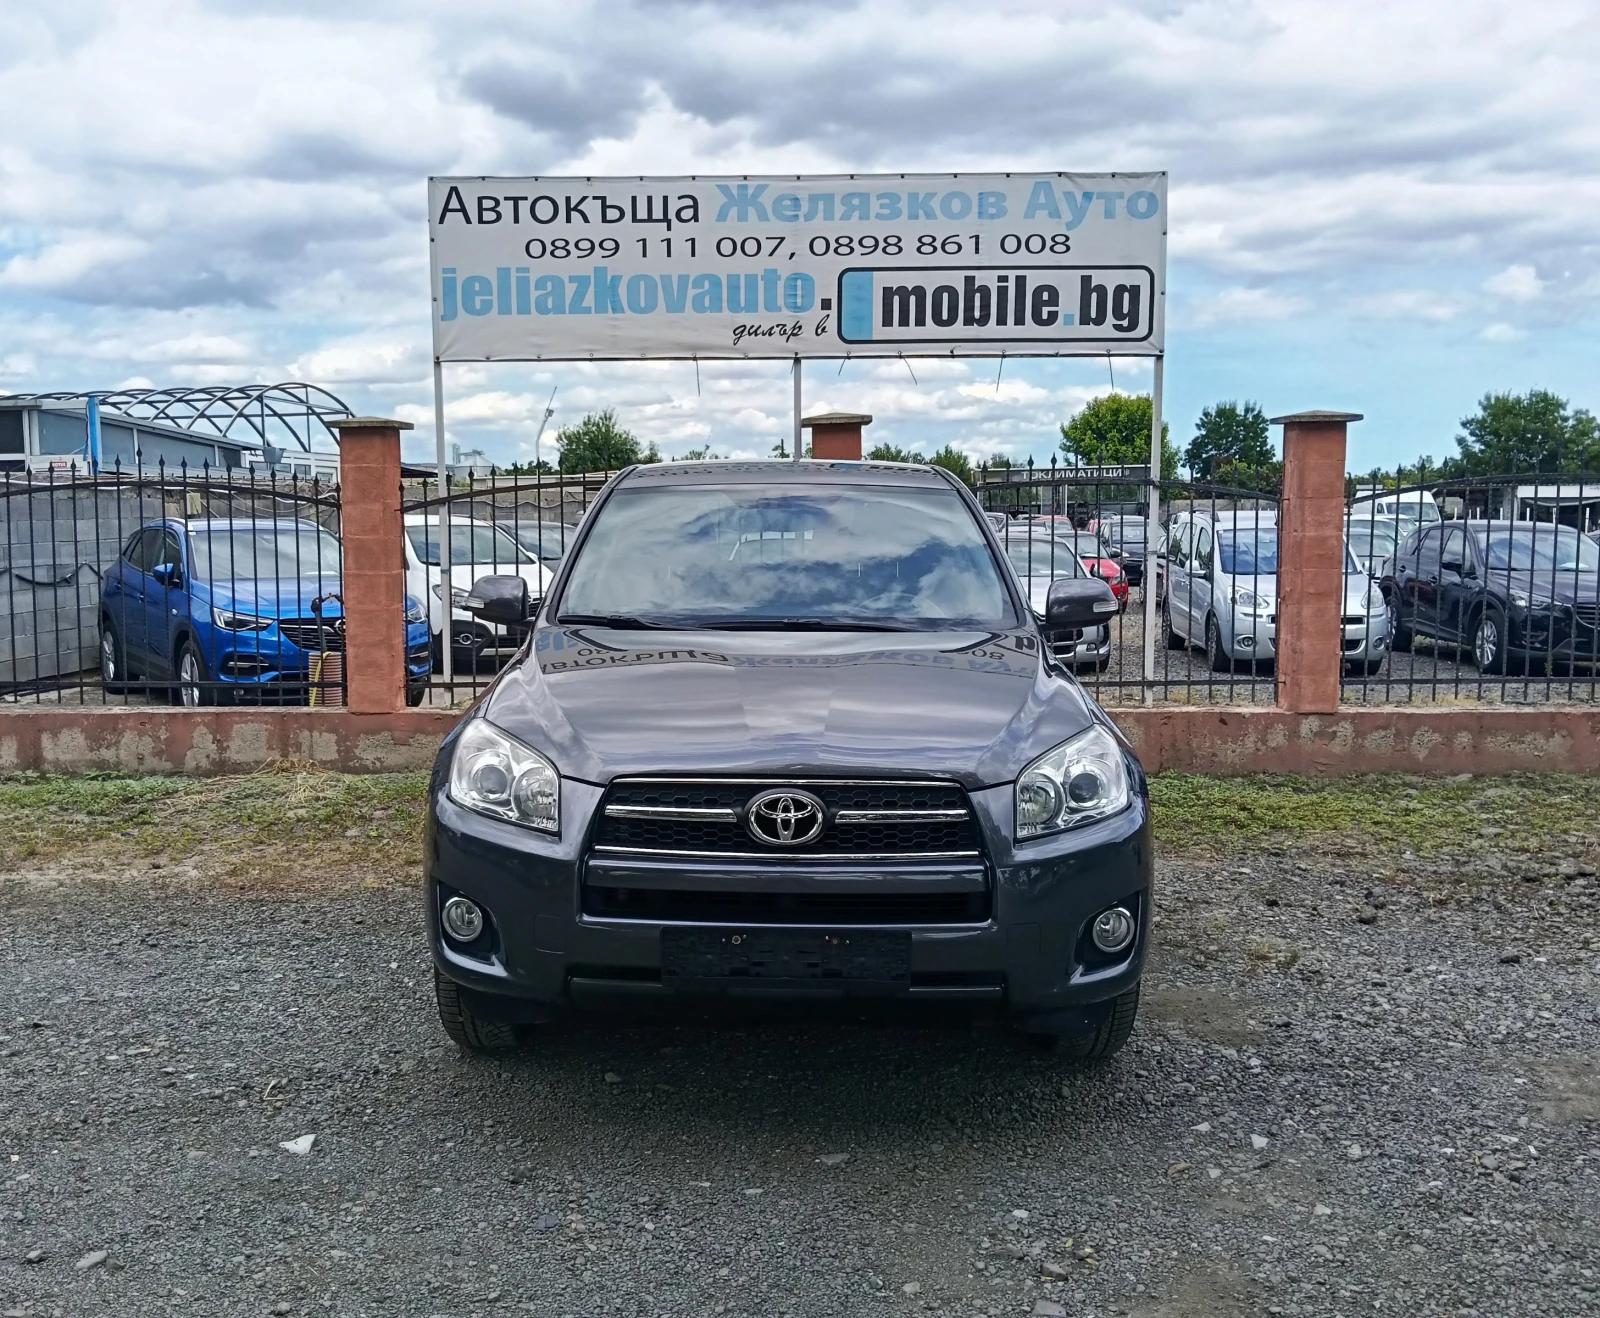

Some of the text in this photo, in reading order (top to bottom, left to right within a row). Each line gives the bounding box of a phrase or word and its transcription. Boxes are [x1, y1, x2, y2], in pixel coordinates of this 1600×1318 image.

[438, 181, 1160, 231] Автокъща Желязков Ауто
[525, 233, 1071, 261] 0899 111 007, 0898 861 008
[881, 274, 1141, 333] mobile.bg
[732, 314, 830, 345] дилър в
